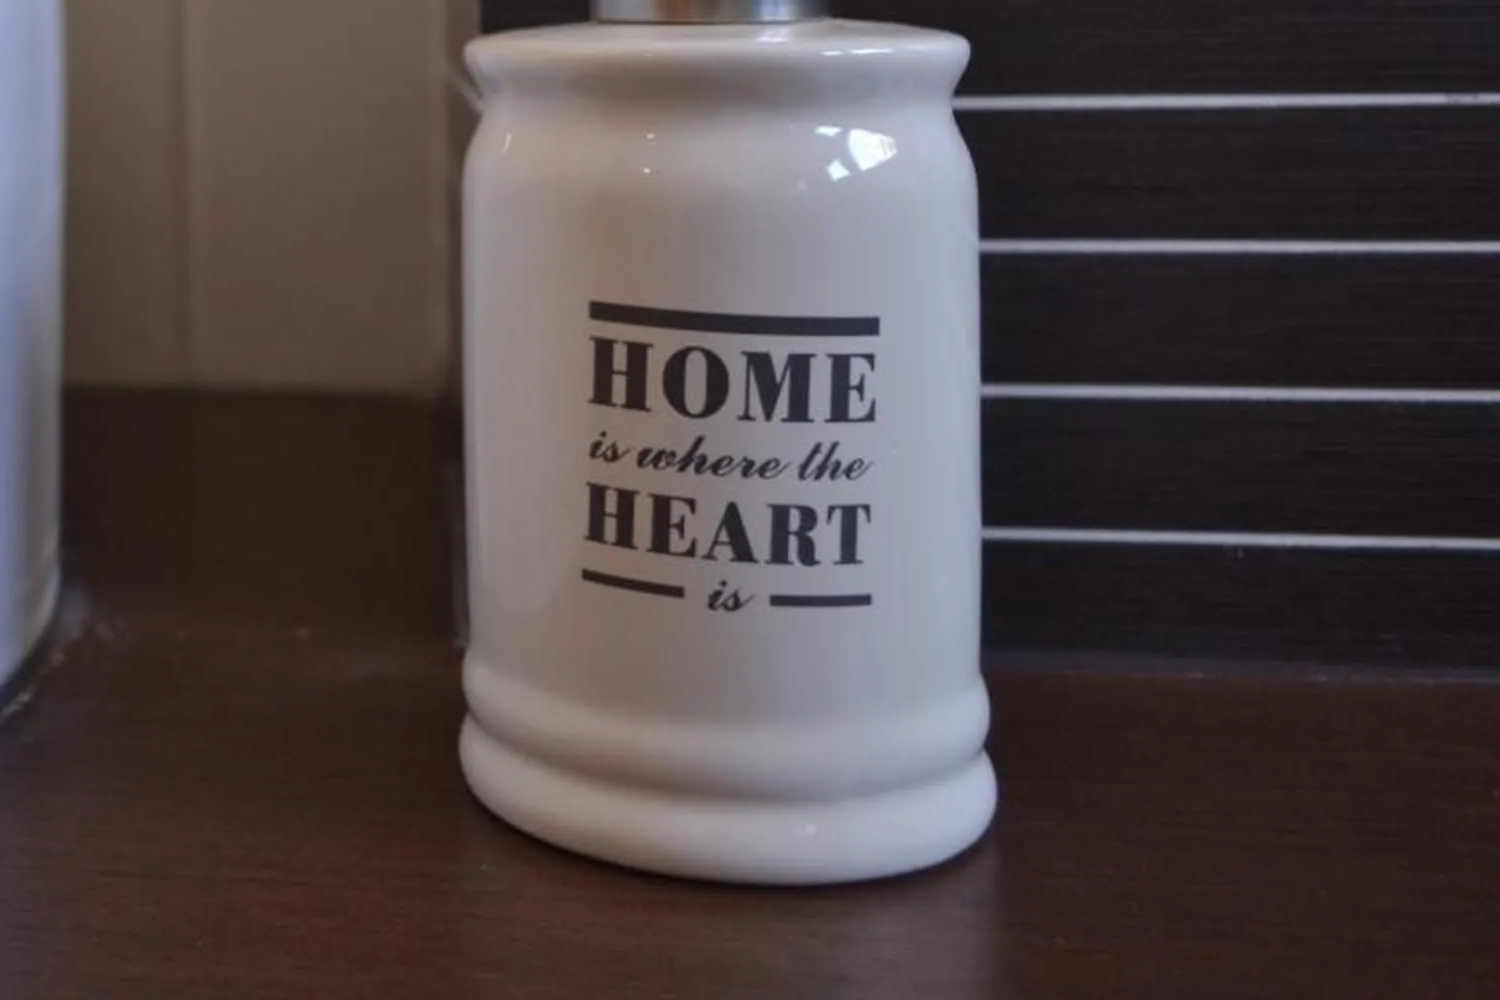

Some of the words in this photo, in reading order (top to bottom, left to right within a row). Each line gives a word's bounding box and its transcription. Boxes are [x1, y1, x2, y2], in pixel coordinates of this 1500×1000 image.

[588, 336, 876, 423] HOME
[589, 431, 631, 463] is
[636, 435, 792, 480] where
[797, 441, 874, 481] the
[584, 481, 871, 567] HEART
[707, 580, 754, 612] is
